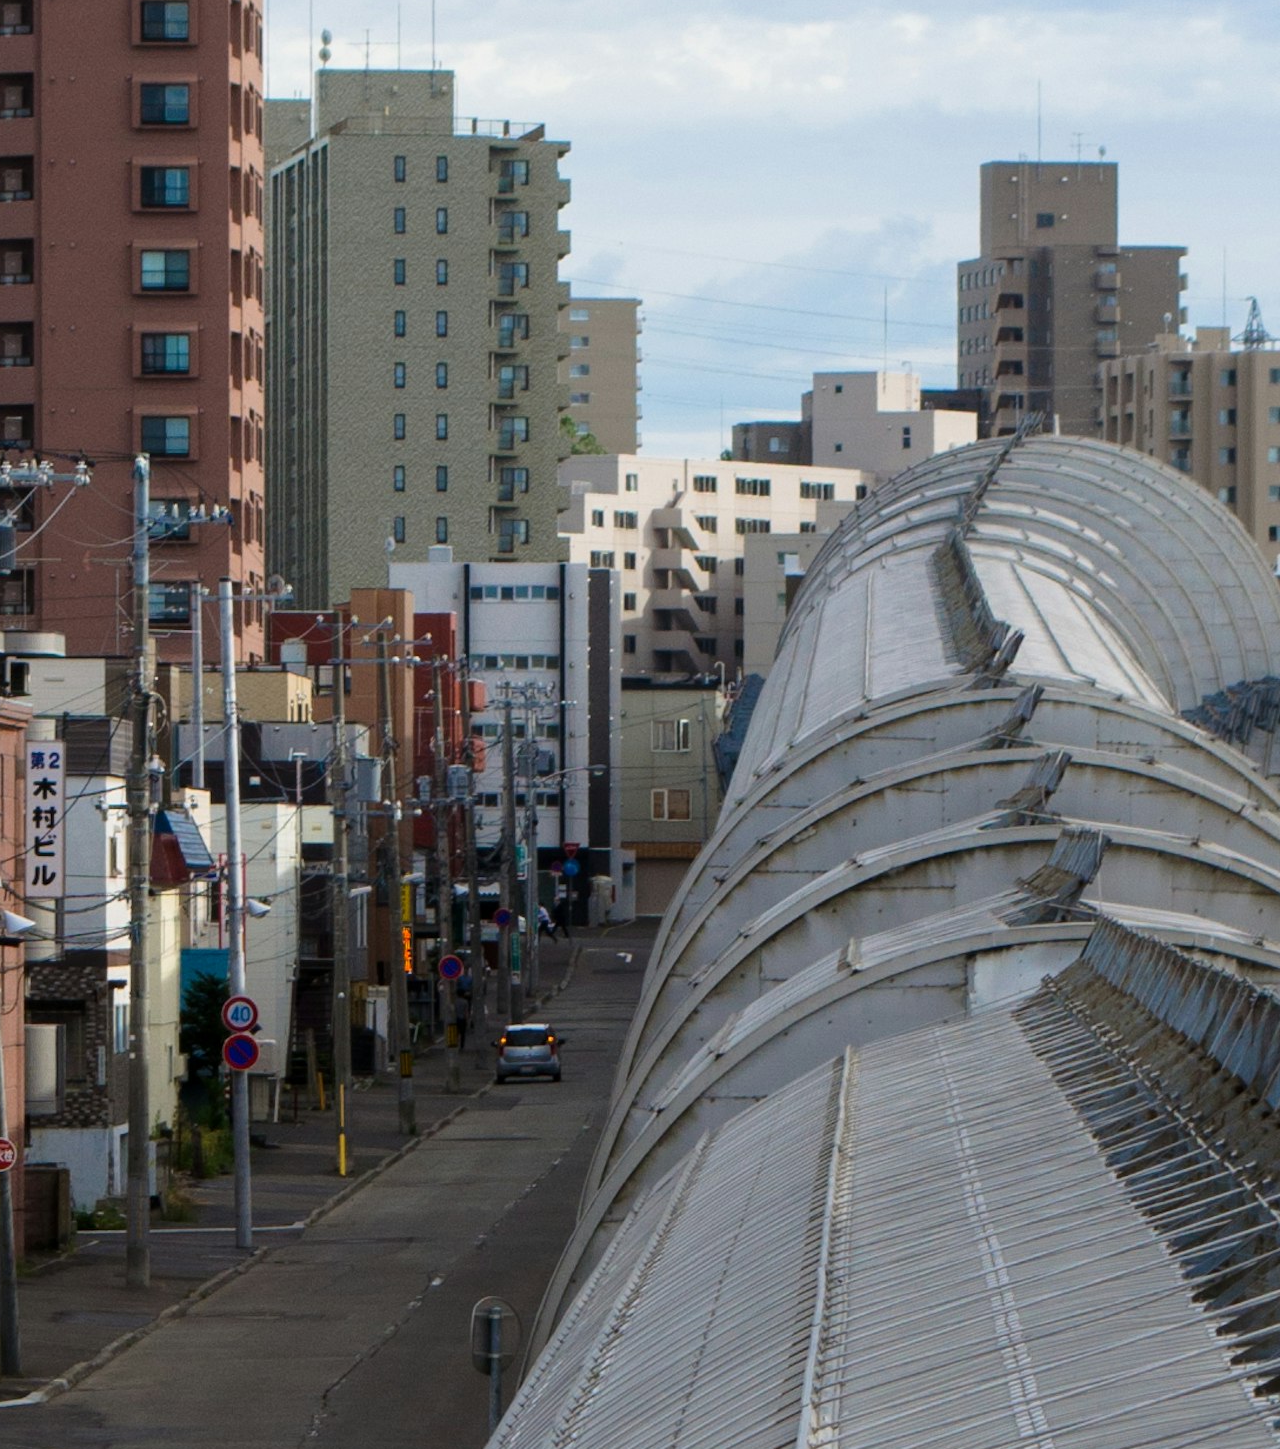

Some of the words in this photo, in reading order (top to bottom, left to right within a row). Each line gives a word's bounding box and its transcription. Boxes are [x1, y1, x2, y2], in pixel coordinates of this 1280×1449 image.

[30, 751, 61, 770] 第2
[31, 777, 58, 887] 木村ビル
[230, 1005, 252, 1023] 40
